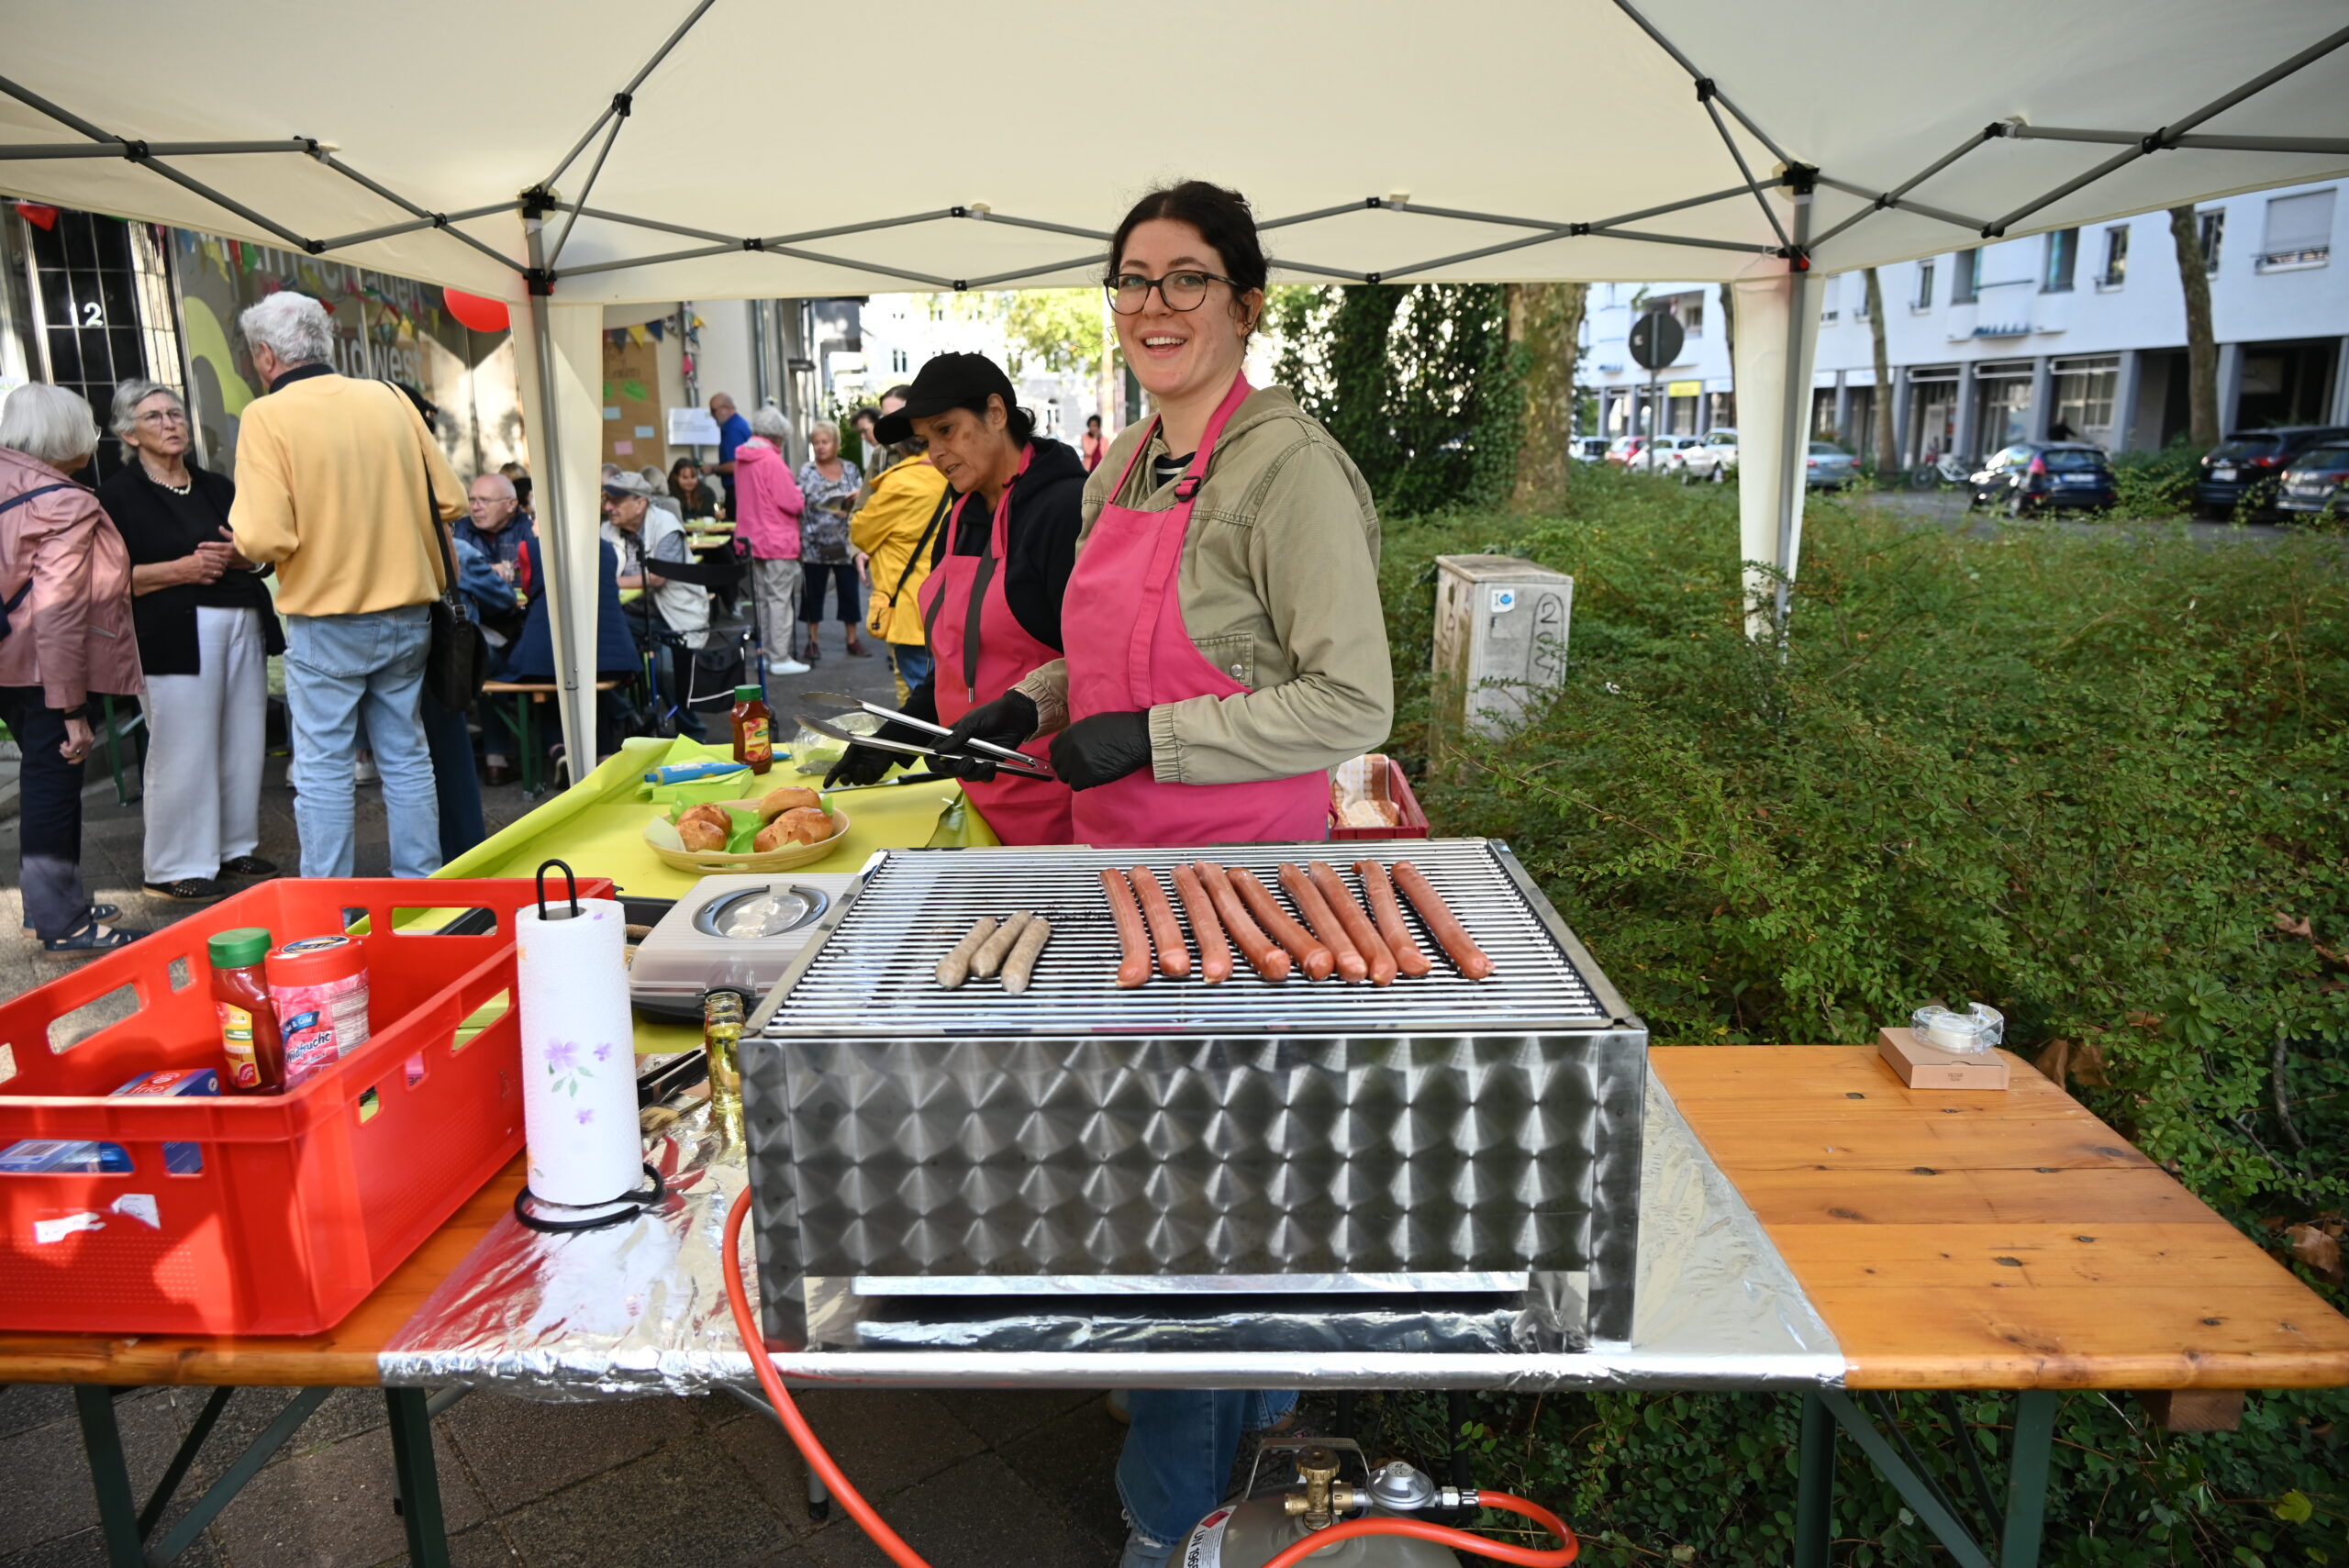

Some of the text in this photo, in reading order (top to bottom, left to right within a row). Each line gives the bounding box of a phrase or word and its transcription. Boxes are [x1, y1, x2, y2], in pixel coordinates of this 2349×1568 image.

[70, 302, 104, 327] 12
[331, 318, 426, 391] üdwest
[1191, 1529, 1206, 1547] UN
